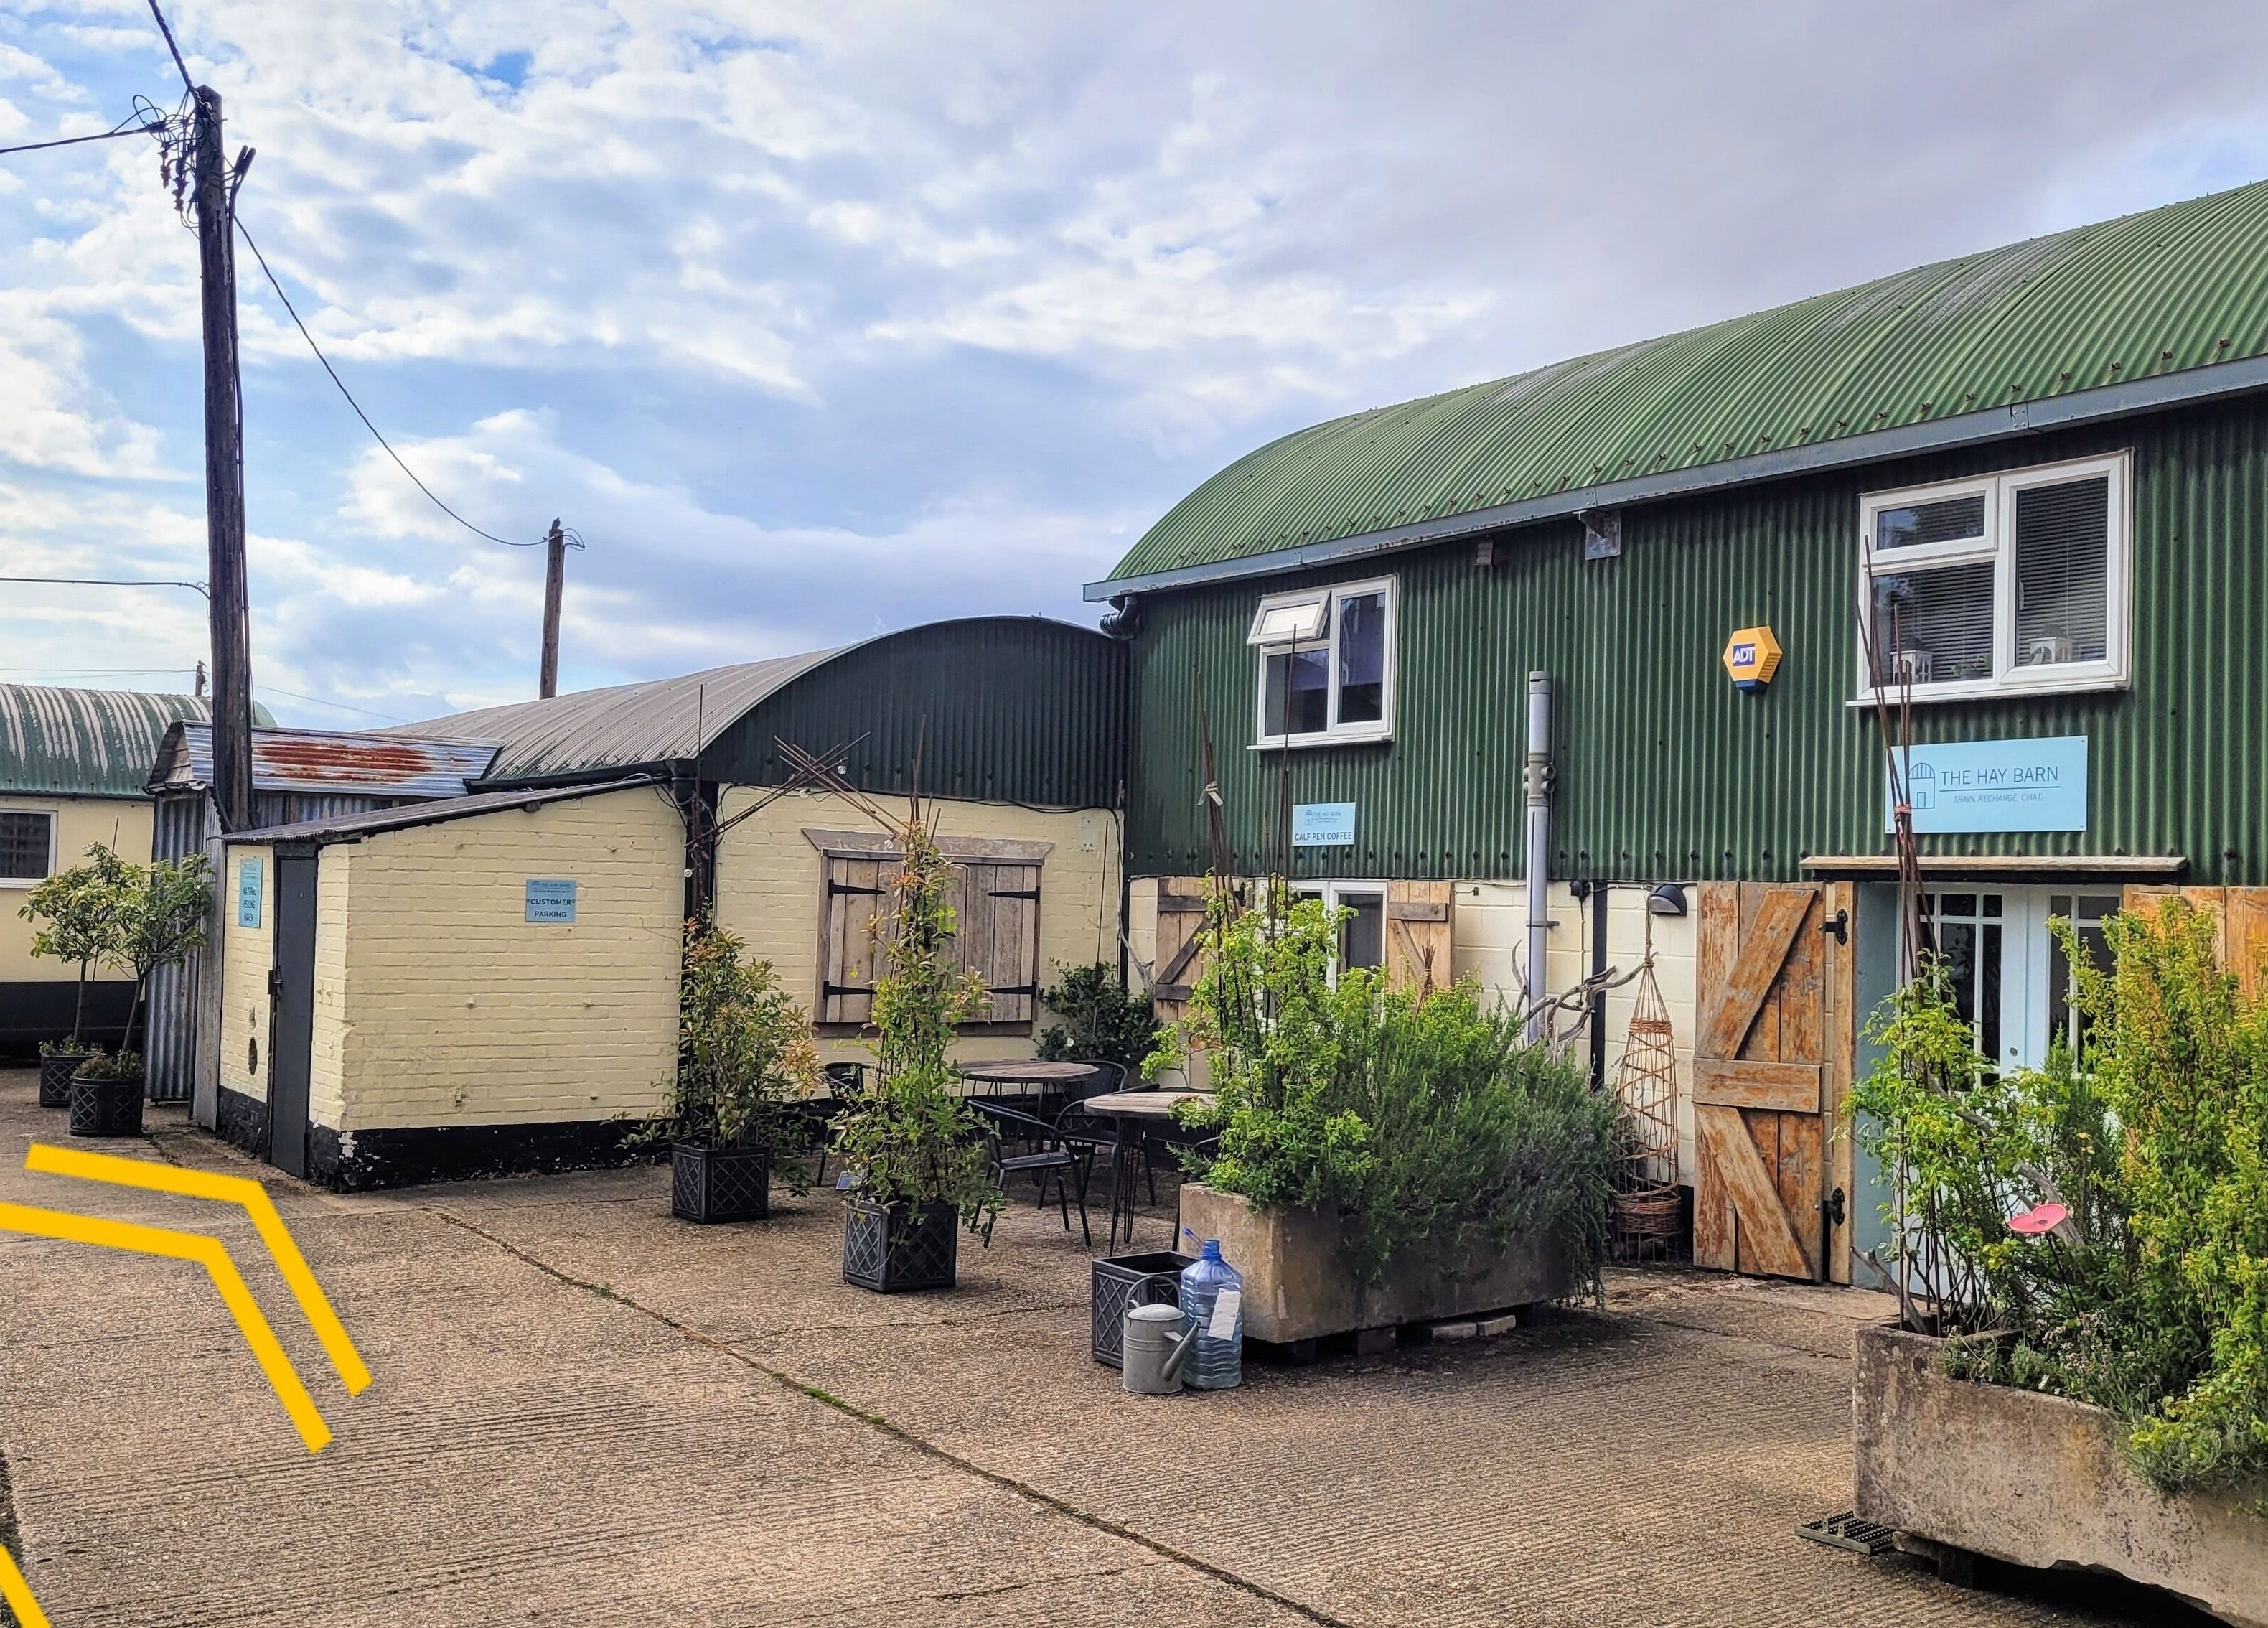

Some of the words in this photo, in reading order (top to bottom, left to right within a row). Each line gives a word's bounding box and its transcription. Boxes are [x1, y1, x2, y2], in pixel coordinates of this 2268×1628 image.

[1733, 646, 1756, 663] ADT
[1940, 770, 1972, 785] THE
[1977, 768, 2007, 784] HAY
[2013, 767, 2058, 782] BARN
[1954, 795, 1977, 803] TRAIN.
[2021, 792, 2043, 802] CHAT.
[1326, 831, 1352, 840] COFFEE
